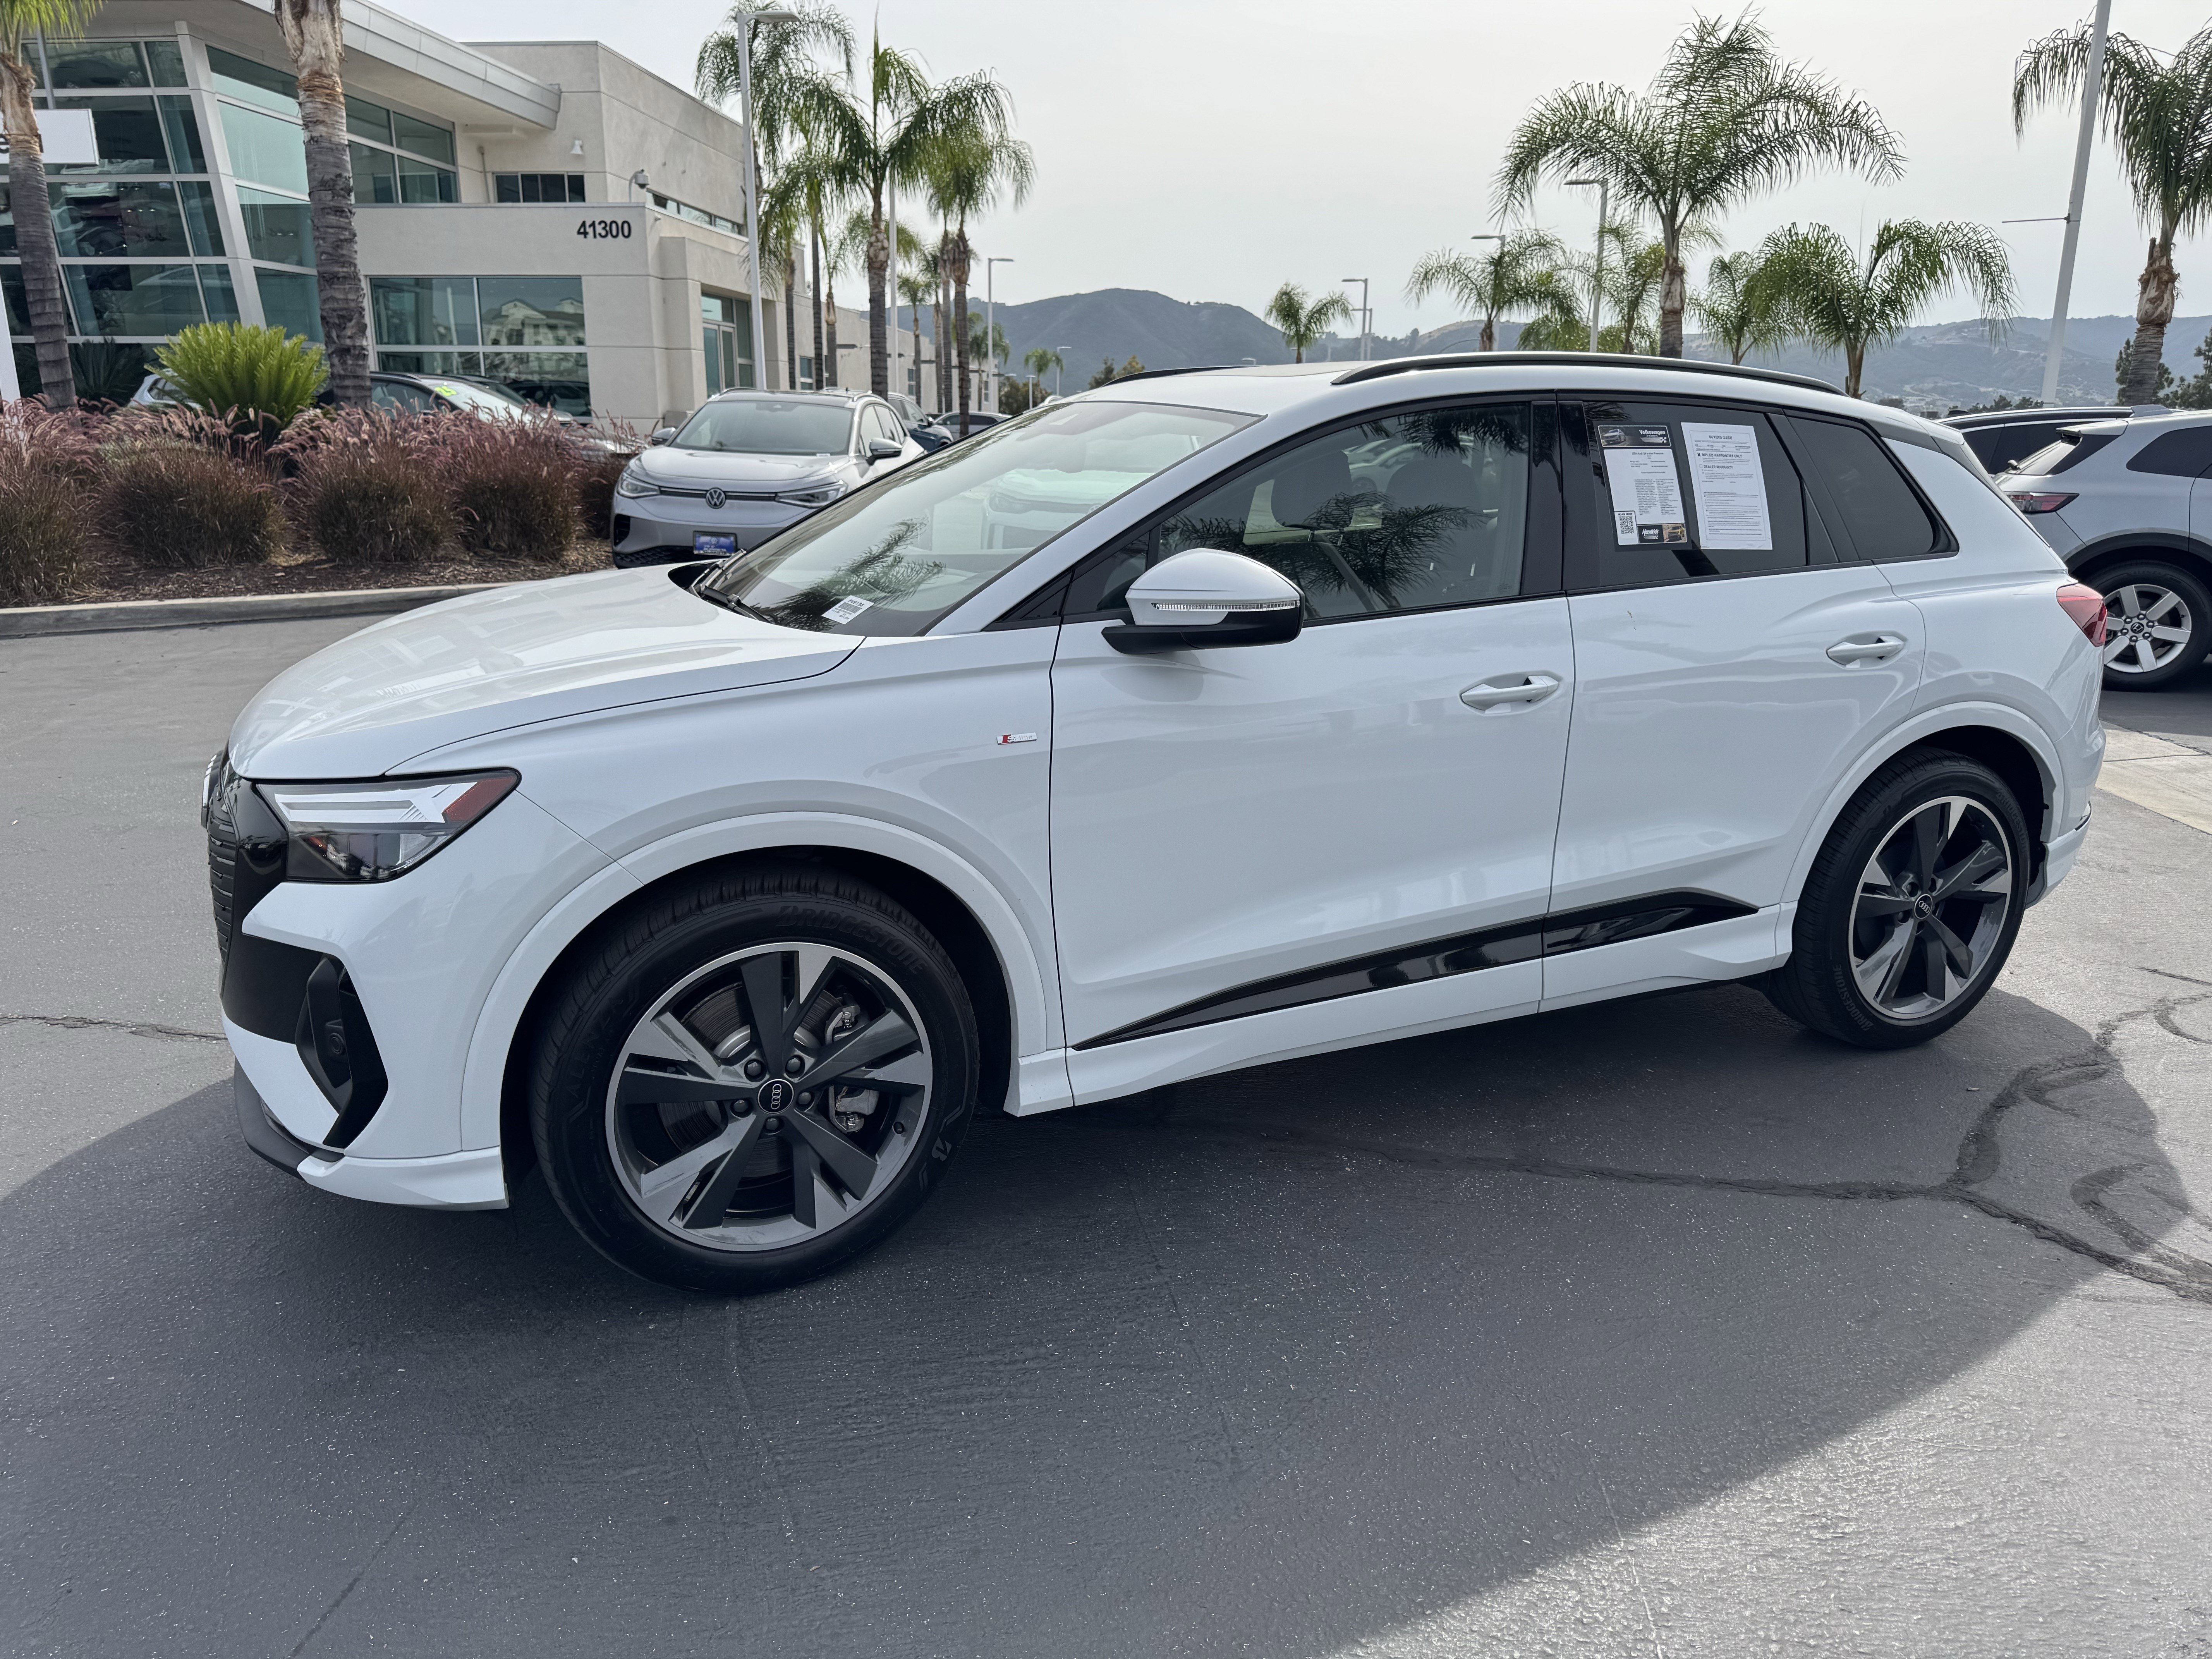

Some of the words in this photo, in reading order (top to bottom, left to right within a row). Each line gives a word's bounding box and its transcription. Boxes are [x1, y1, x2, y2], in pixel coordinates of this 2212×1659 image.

[577, 220, 631, 239] 41300
[775, 905, 927, 974] BRIDGESTONE
[1832, 963, 1874, 1031] BRIDGESTONE
